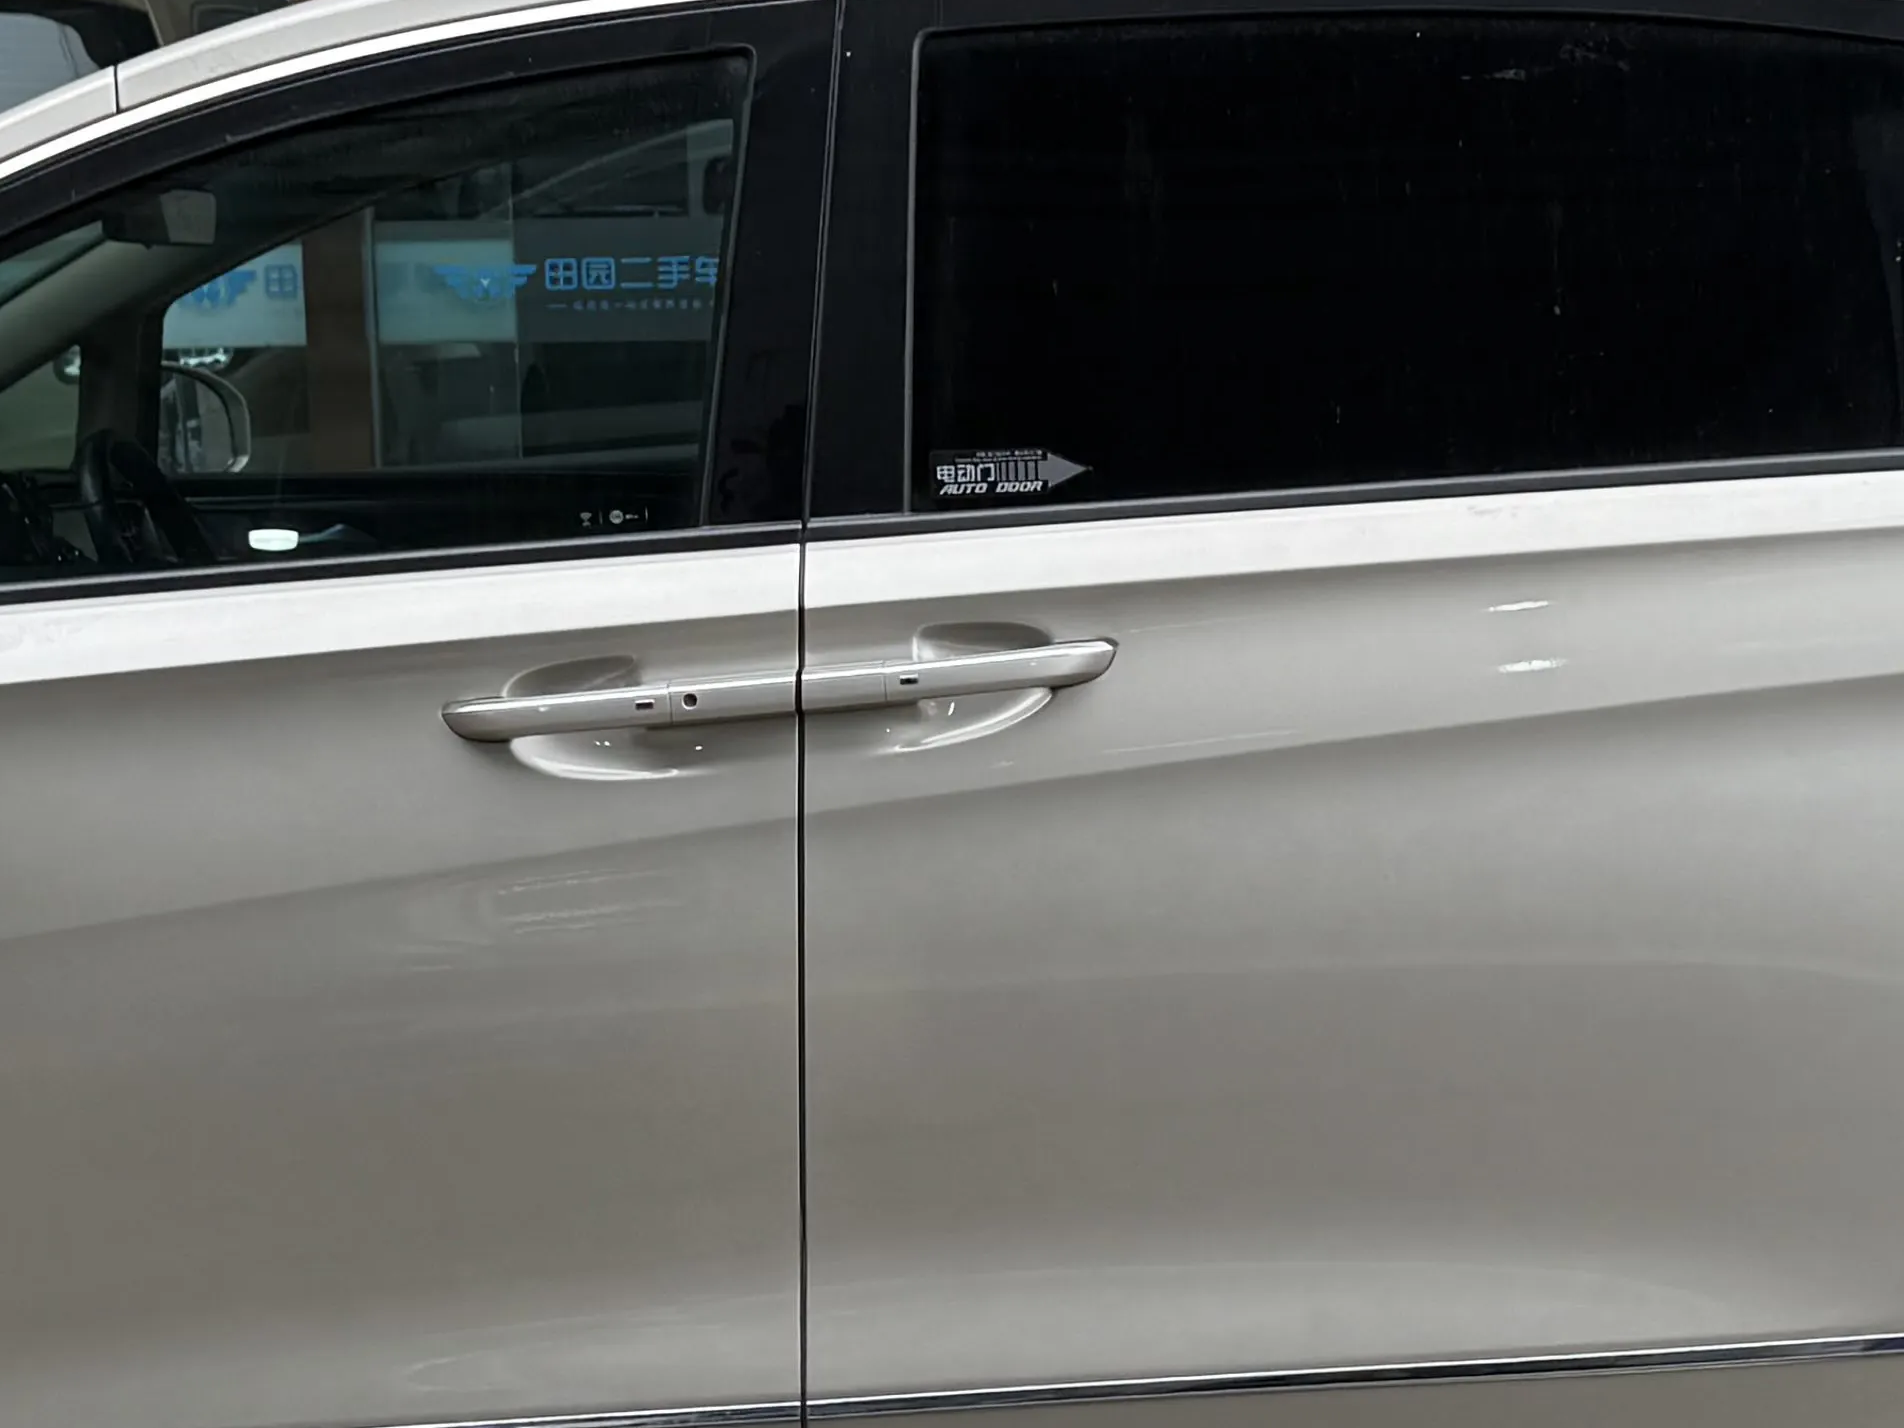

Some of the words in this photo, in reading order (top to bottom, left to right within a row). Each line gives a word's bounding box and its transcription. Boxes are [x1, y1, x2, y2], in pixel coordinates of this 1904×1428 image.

[937, 463, 995, 483] 电动门
[939, 483, 988, 495] AUTO
[996, 481, 1043, 493] DOOR
